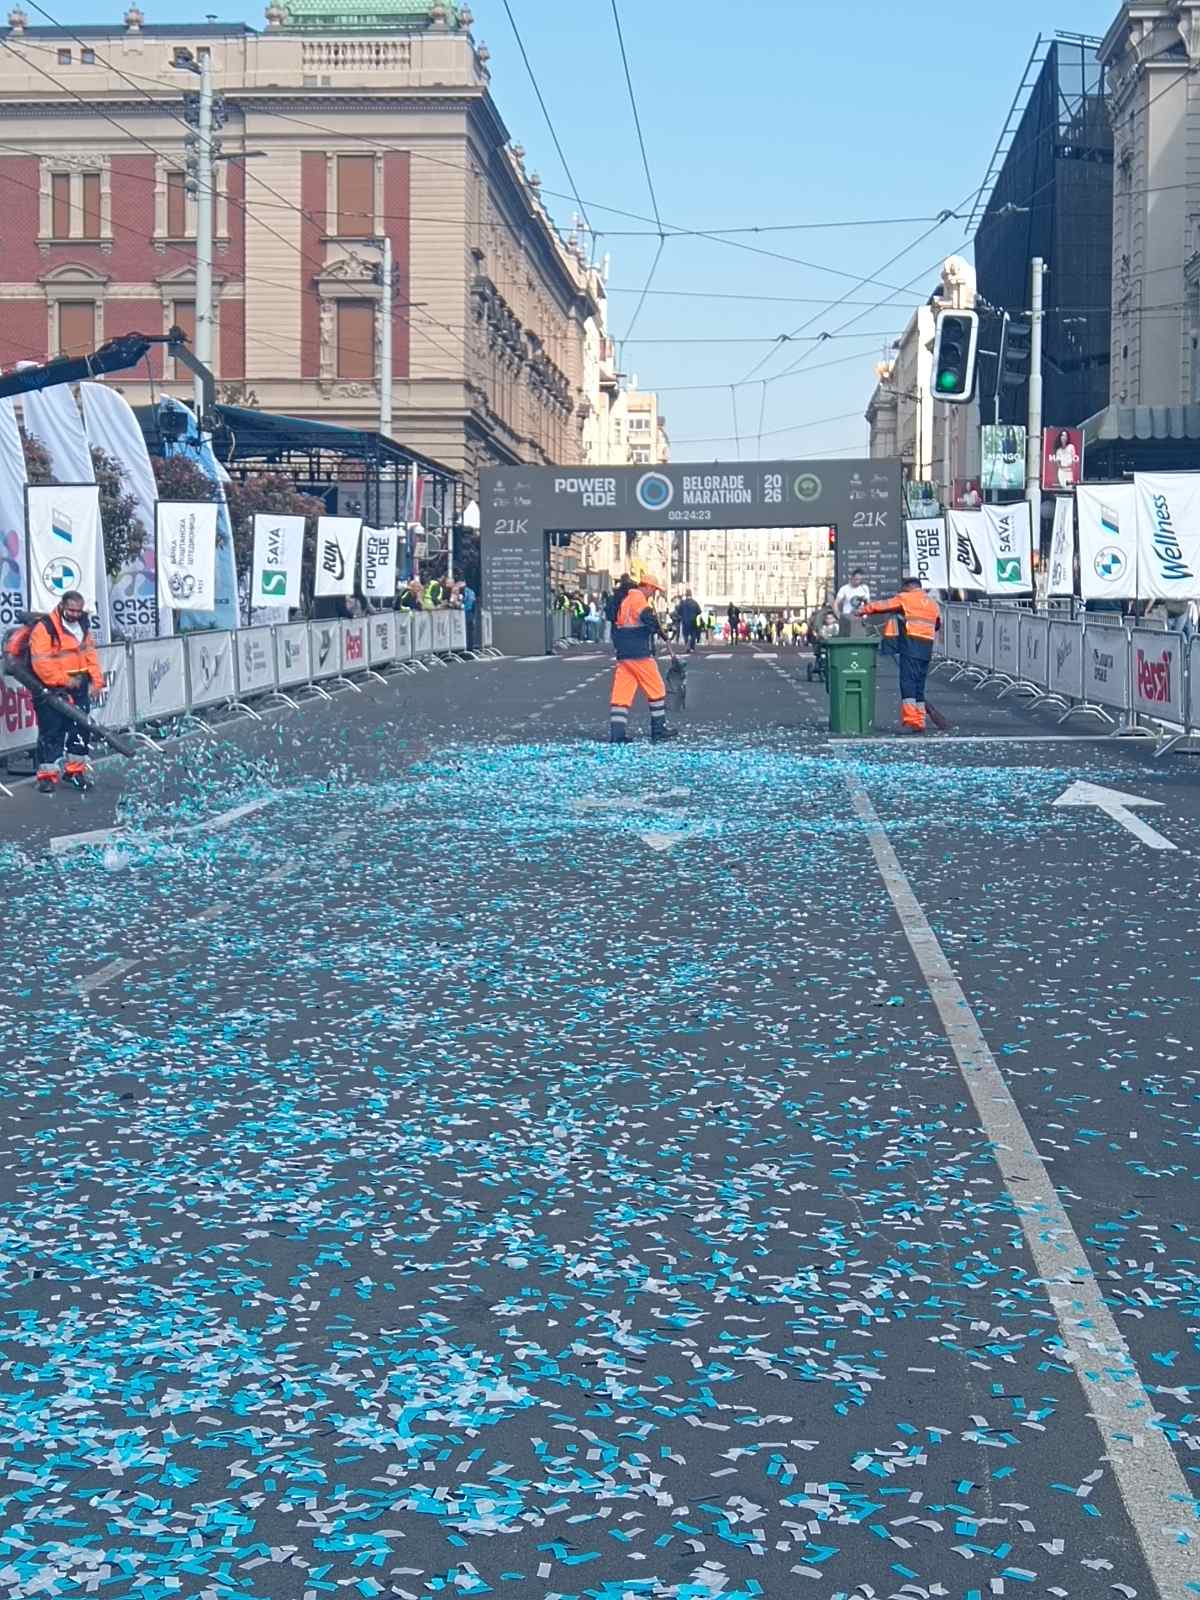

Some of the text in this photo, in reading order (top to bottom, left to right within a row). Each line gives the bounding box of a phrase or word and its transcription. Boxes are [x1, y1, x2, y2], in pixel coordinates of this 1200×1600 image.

[1048, 454, 1080, 462] MAO
[554, 478, 616, 493] POWER
[682, 475, 745, 490] BELGRADE
[763, 474, 782, 488] 20
[582, 492, 617, 507] ADE
[682, 489, 752, 504] MARATHON
[763, 489, 782, 503] 26
[494, 518, 529, 534] 21K
[852, 511, 888, 527] 21K
[927, 527, 940, 557] ADE
[999, 515, 1011, 552] SAVA
[1151, 494, 1194, 579] Wellness
[267, 528, 281, 565] SAVA
[322, 540, 338, 573] RUN
[378, 537, 390, 566] ADE
[915, 528, 929, 581] POWER
[957, 531, 971, 566] RUN
[366, 537, 379, 589] POWER
